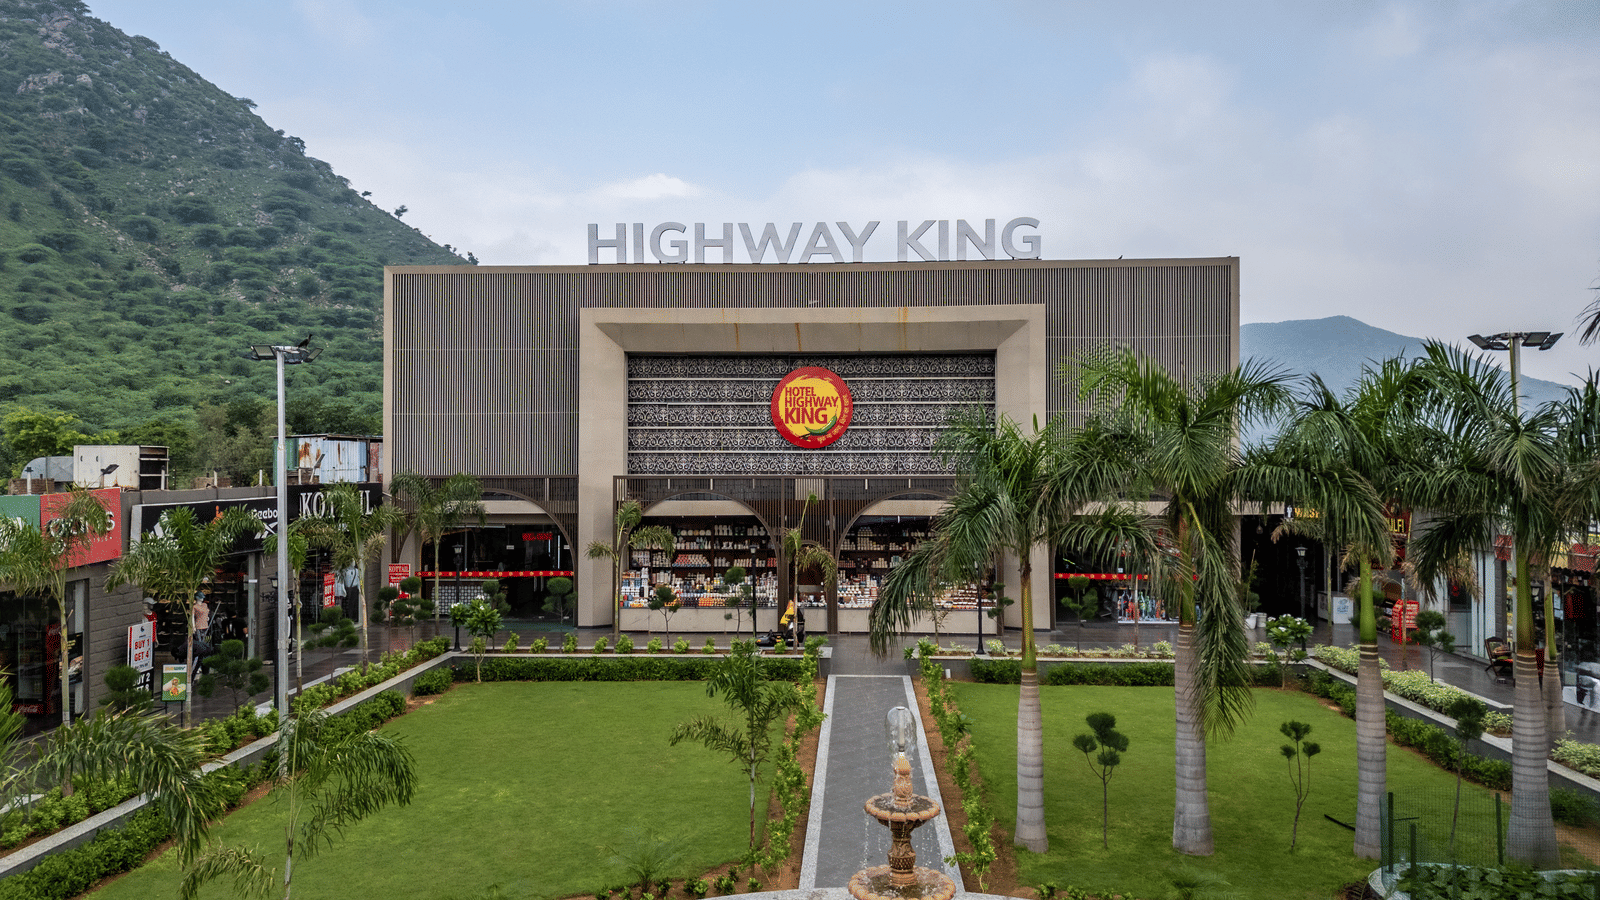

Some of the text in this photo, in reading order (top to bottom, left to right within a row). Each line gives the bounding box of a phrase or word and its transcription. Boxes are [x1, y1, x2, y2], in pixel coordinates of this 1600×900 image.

[588, 217, 1041, 265] HIGHWAY KING
[785, 386, 816, 397] HOTEL
[785, 396, 839, 408] HIGHWAY
[785, 407, 828, 425] KING
[251, 507, 279, 520] Reebo
[134, 640, 146, 650] BUY
[134, 652, 145, 662] GET
